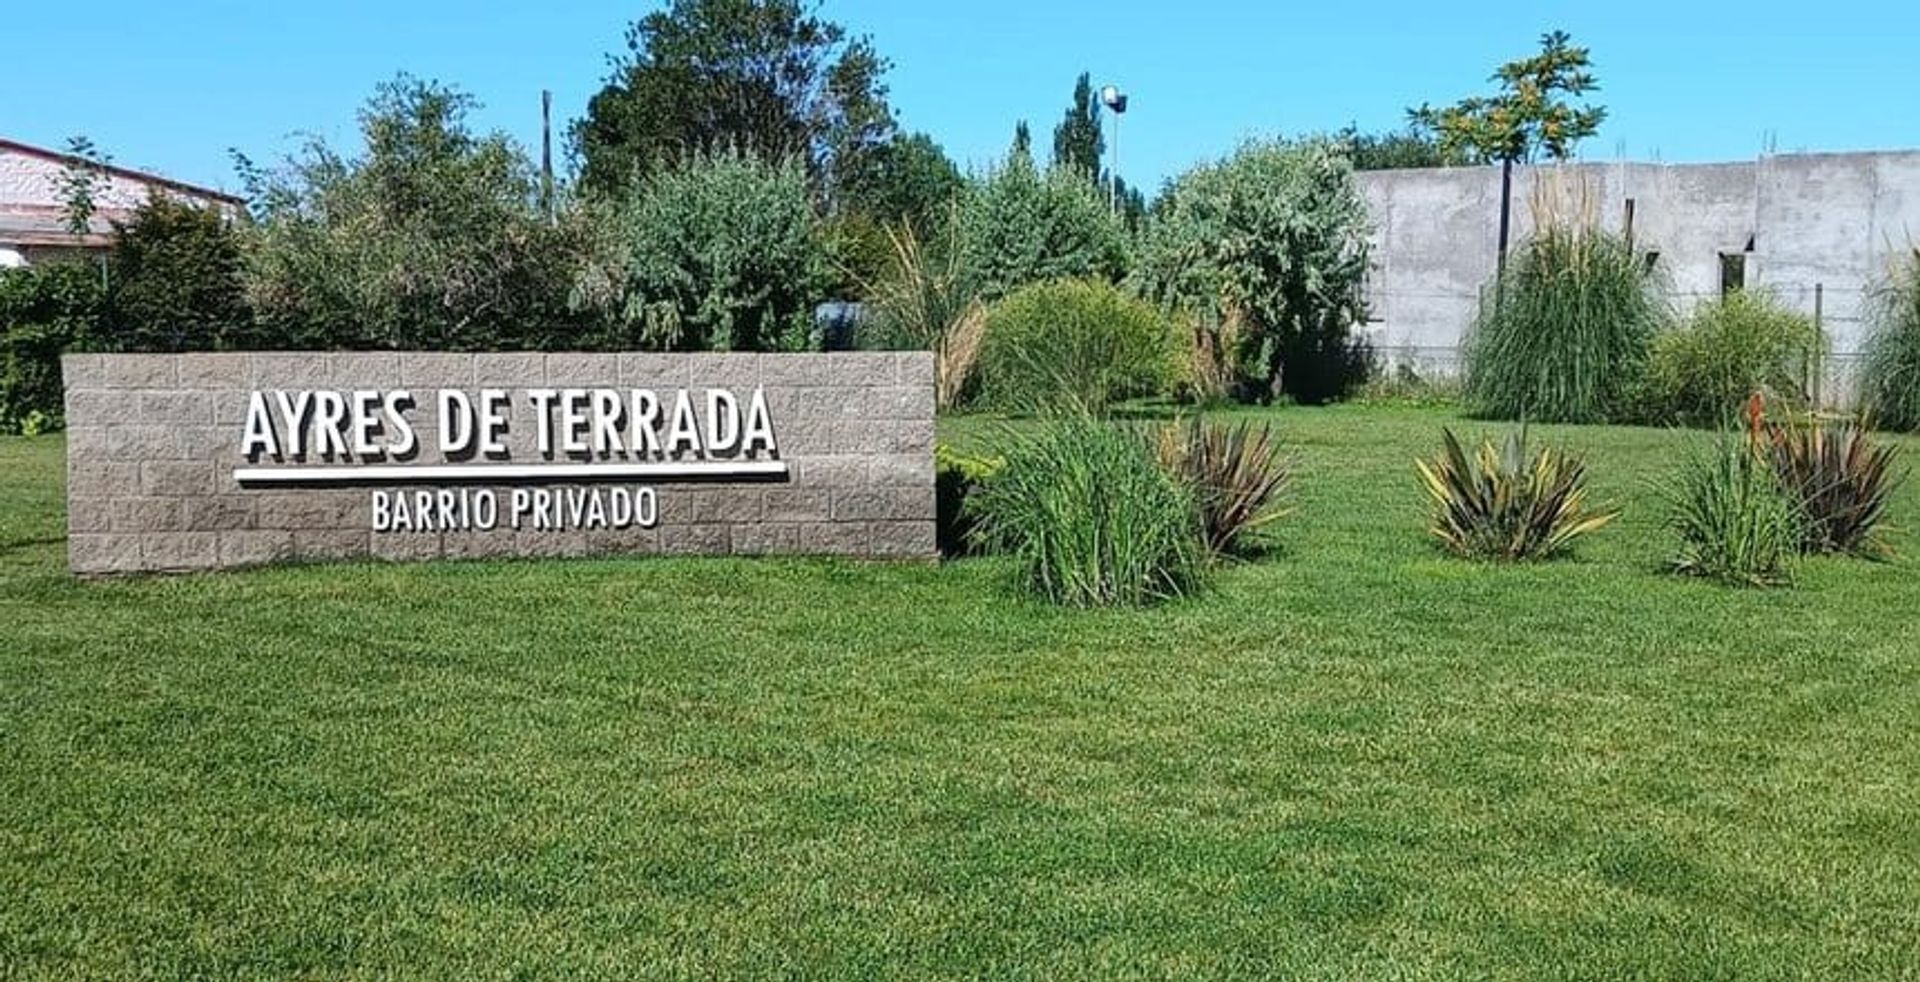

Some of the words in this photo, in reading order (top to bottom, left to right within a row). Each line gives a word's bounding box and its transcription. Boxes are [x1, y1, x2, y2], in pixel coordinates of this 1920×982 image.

[241, 389, 416, 456] AYRES
[437, 388, 507, 454] DE
[528, 384, 777, 453] TERRADA
[372, 489, 498, 531] BARRIO
[511, 486, 657, 529] PRIVADO
